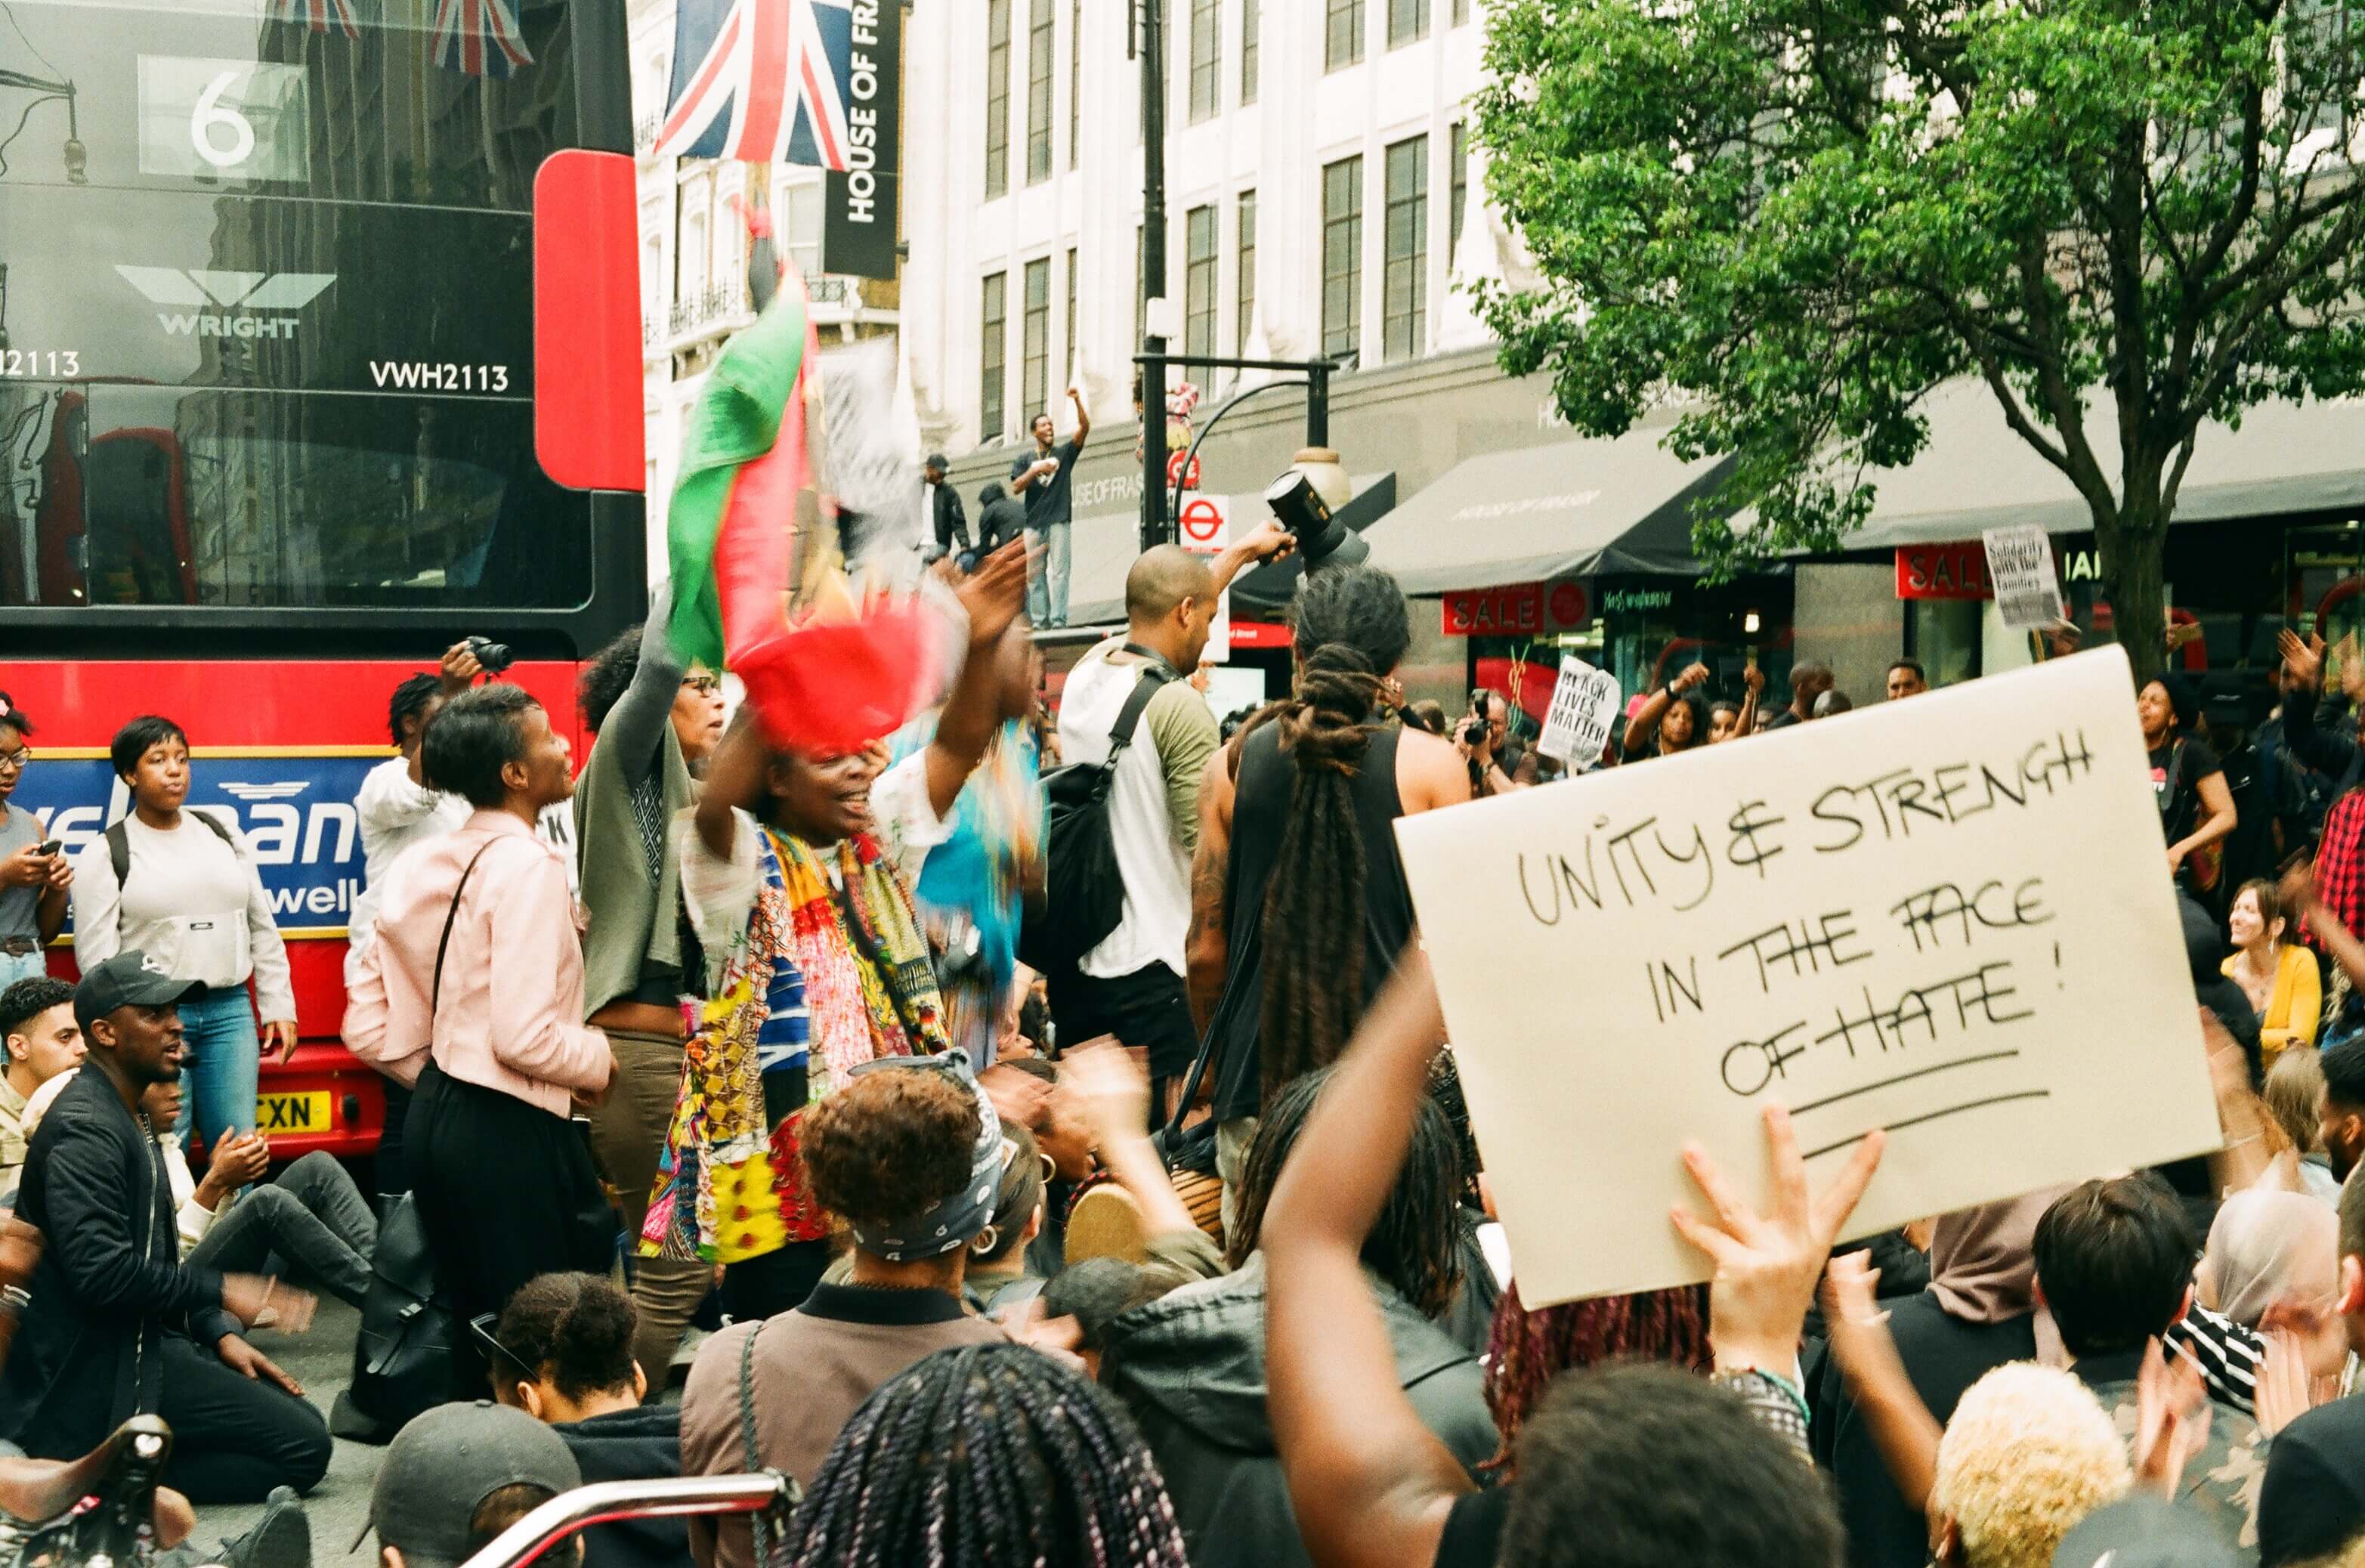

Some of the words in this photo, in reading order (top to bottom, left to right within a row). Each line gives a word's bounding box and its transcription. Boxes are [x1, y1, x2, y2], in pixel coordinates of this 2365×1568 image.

[849, 51, 877, 101] OF
[191, 71, 256, 166] 6
[848, 107, 877, 224] HOUSE
[158, 312, 301, 339] WRIGHT
[369, 360, 509, 392] VWH2113
[1453, 597, 1536, 630] SALE
[1556, 688, 1597, 718] LIVES
[1562, 670, 1609, 701] BLACK
[1550, 707, 1606, 744] MATTER
[1727, 800, 1786, 879] &
[264, 878, 358, 914] well
[1646, 954, 1704, 1023] IN
[1717, 910, 1875, 993] THE
[1889, 878, 2057, 954] FACE
[1721, 1020, 1807, 1096] OF
